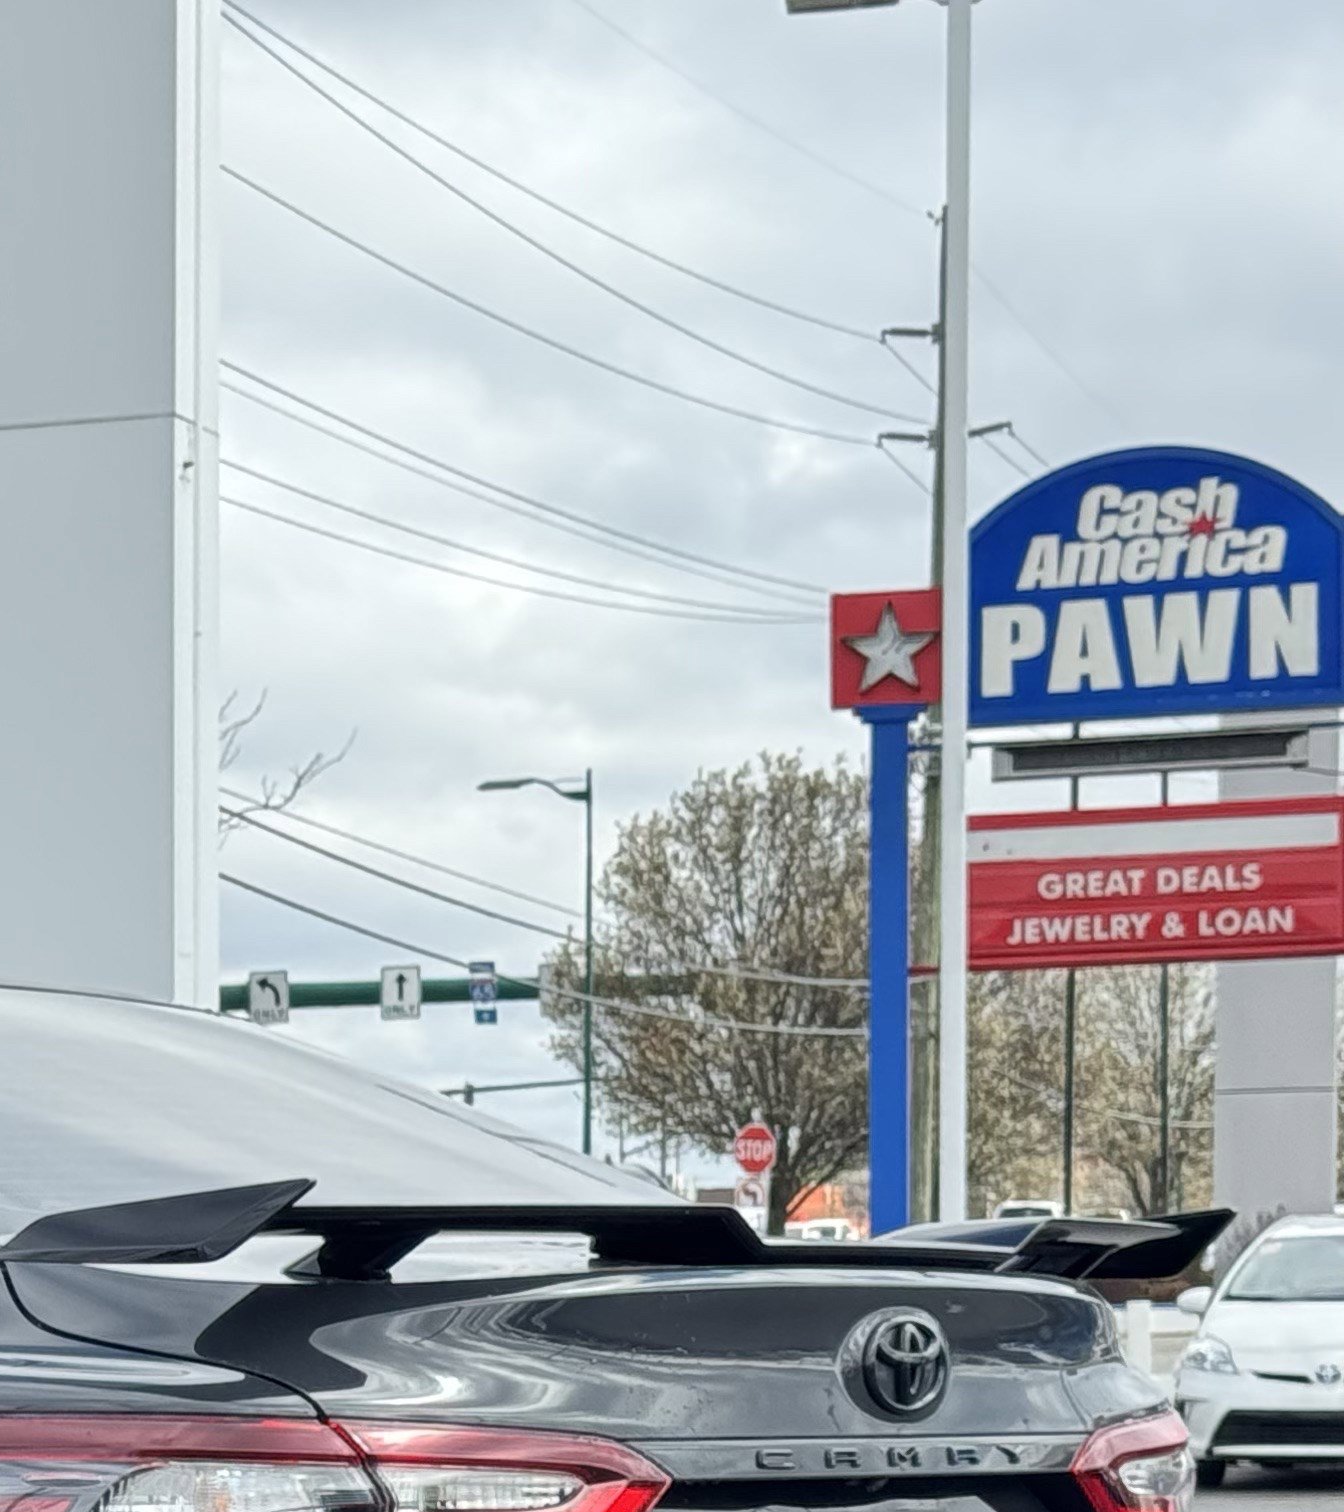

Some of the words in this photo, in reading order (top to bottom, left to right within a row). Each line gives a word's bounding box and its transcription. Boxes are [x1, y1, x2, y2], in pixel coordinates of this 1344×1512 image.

[1077, 476, 1238, 540] Cash
[1016, 525, 1286, 591] America
[980, 582, 1318, 698] PAWN
[1037, 869, 1145, 899] GREAT
[1157, 863, 1262, 894] DEALS
[1006, 912, 1151, 945] JEWELRY
[1161, 912, 1185, 939] &
[1198, 906, 1295, 936] LOAN
[735, 1139, 773, 1161] STOP
[754, 1445, 1025, 1470] CAMRY
